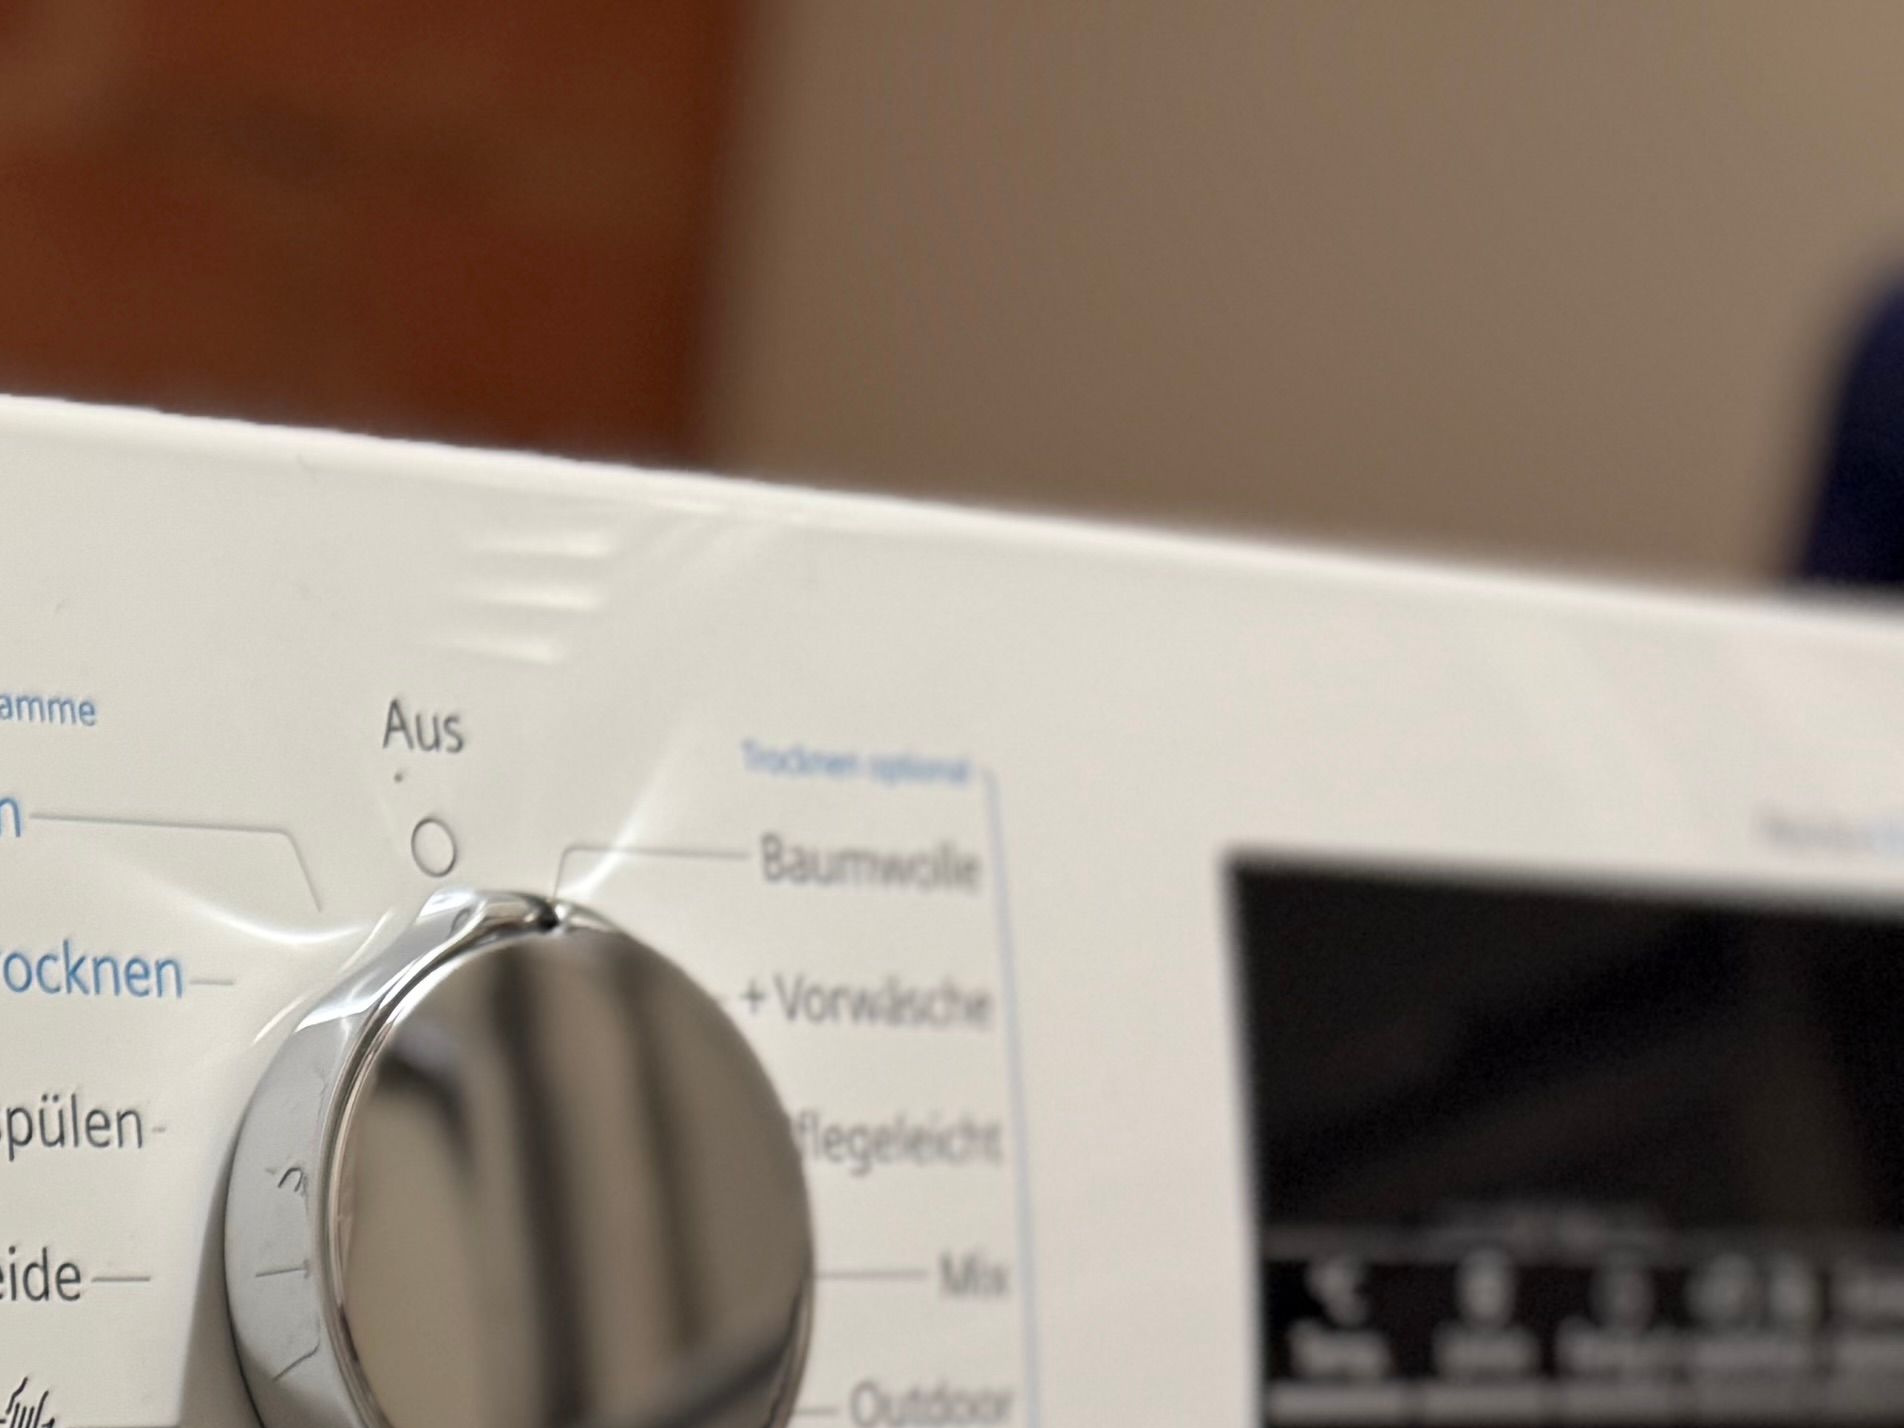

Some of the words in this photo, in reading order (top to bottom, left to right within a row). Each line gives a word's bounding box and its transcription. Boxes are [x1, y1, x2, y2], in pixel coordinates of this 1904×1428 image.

[382, 698, 465, 754] Aus
[760, 832, 982, 895] Baumwolle
[774, 970, 992, 1030] Vorwäsche
[795, 1112, 1004, 1176] flegeleicht
[938, 1251, 1010, 1297] Mix
